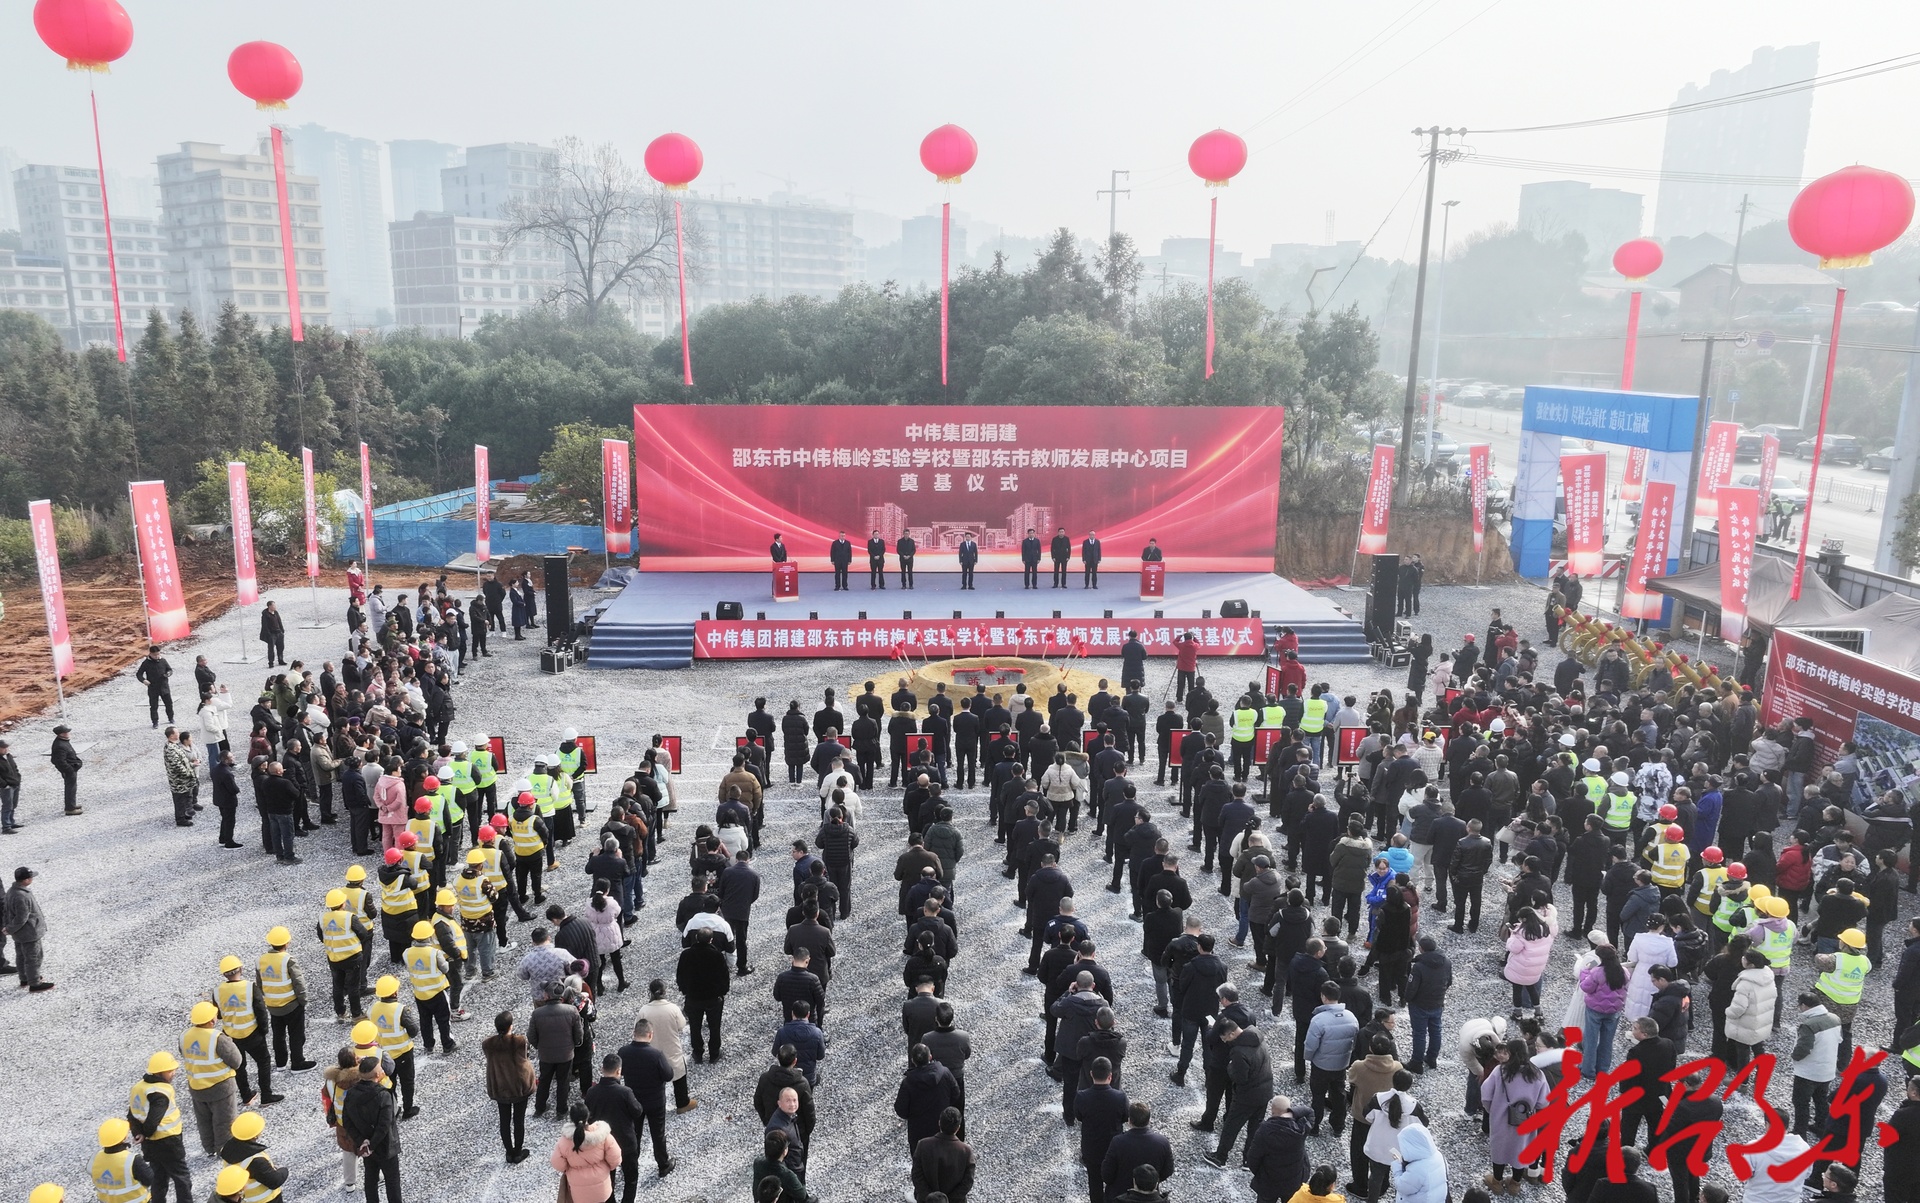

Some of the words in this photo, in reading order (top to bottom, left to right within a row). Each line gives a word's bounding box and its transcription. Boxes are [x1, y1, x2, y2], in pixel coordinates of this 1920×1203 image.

[905, 423, 1017, 442] 中伟集团捐建
[732, 448, 1188, 468] 邵东市中伟梅岭实验学校暨邵东市教师发展中心项目
[900, 473, 1018, 492] 奠基仪式
